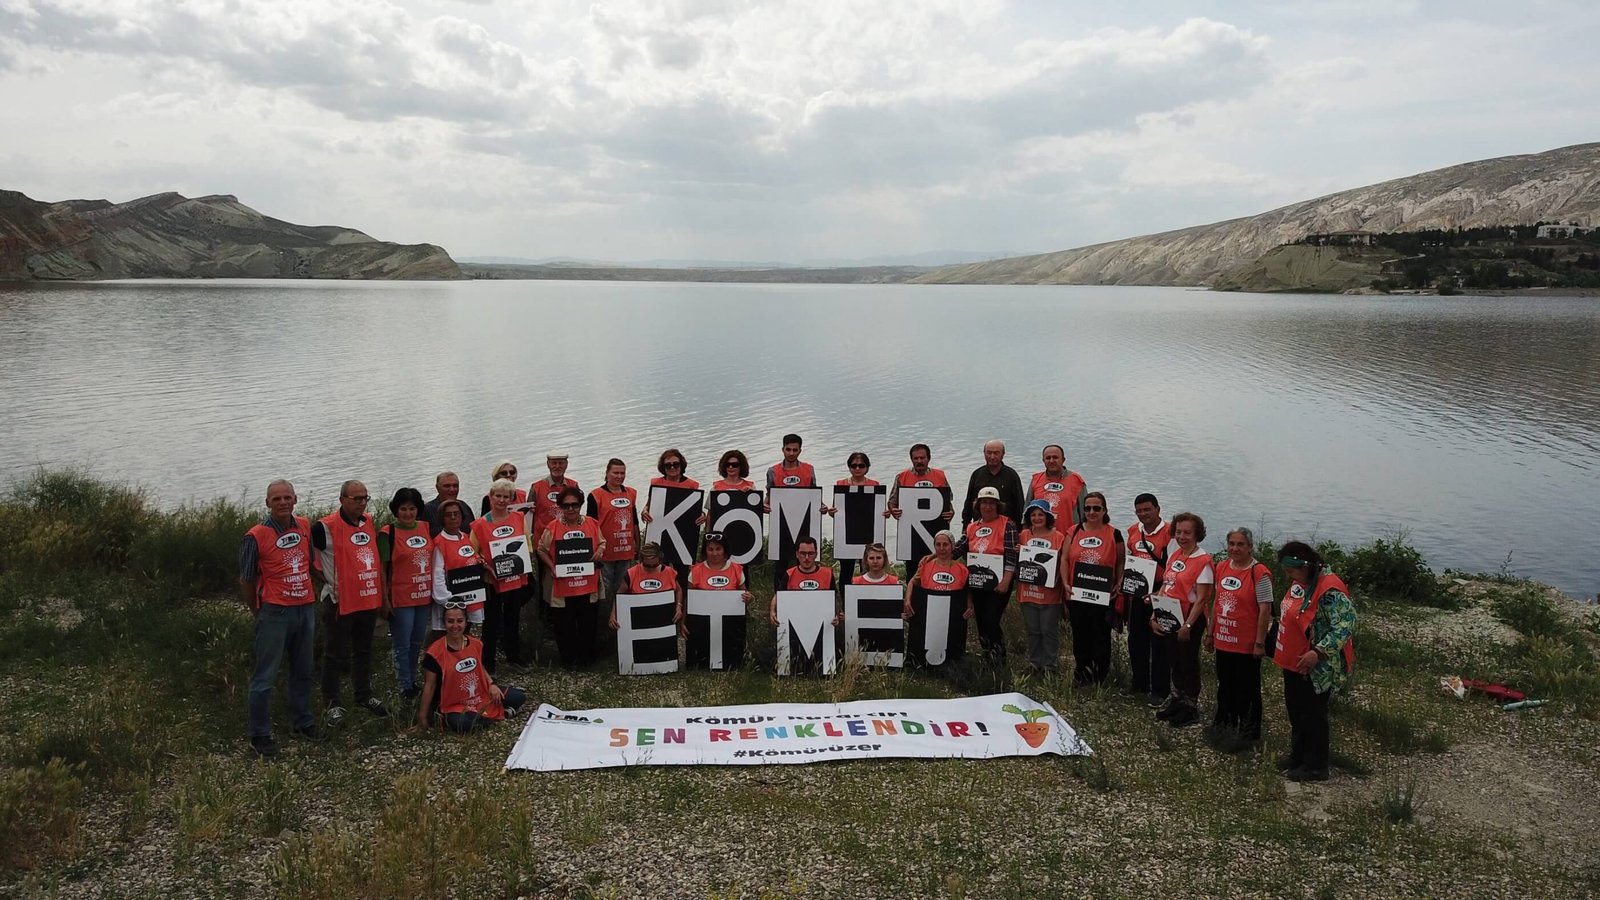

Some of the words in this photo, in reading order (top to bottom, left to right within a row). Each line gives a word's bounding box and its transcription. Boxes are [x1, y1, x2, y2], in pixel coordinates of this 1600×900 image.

[645, 485, 944, 565] KÖMÜR
[616, 585, 951, 676] ETME!
[609, 728, 686, 747] SEN
